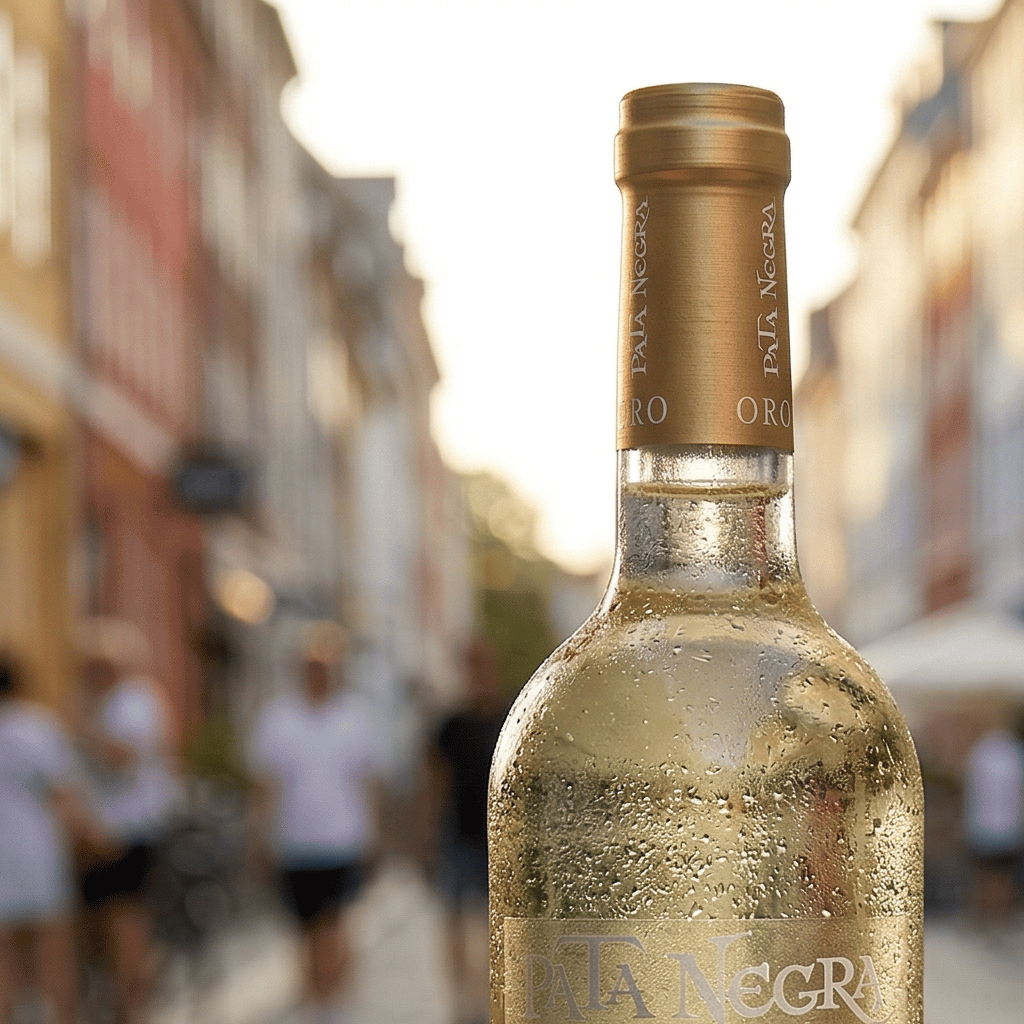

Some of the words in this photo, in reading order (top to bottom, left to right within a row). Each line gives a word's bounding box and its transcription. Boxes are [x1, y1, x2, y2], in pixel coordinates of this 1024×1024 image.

[755, 197, 778, 300] NEGRA
[629, 304, 648, 379] PATA
[757, 306, 780, 378] PATA
[622, 395, 668, 427] RO
[736, 395, 792, 428] ORO
[522, 933, 657, 1022] PATA
